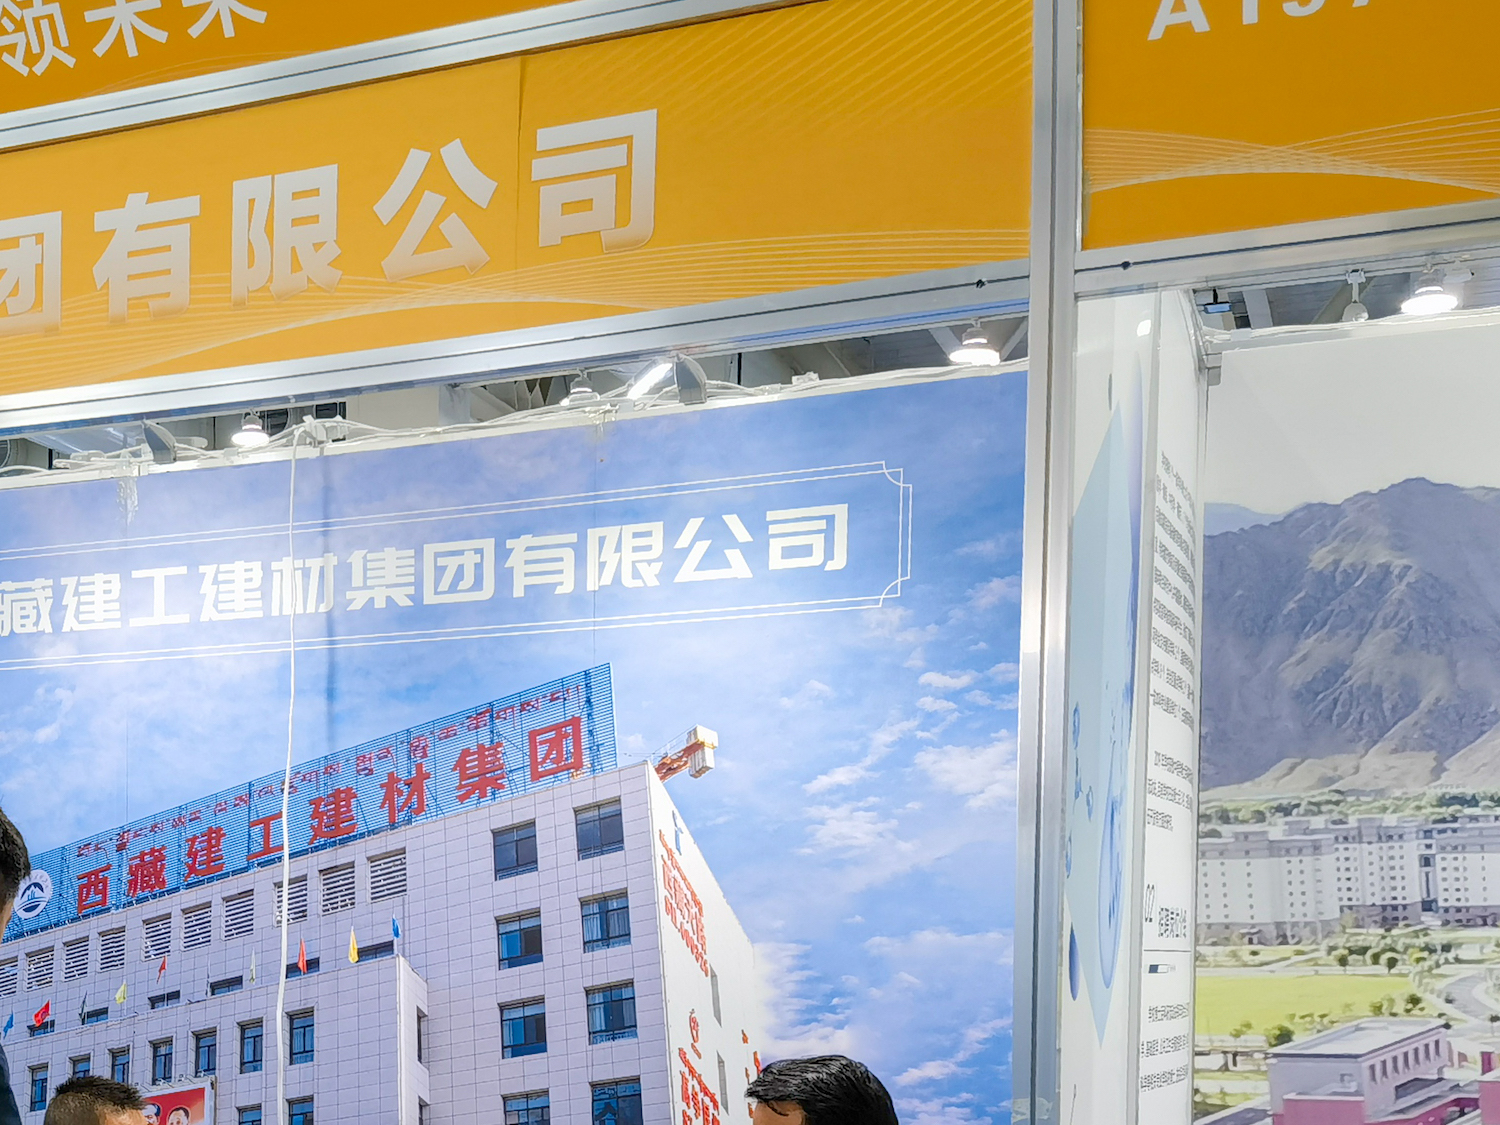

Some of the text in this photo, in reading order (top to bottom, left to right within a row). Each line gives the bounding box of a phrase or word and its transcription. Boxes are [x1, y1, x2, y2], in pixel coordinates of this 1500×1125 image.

[76, 715, 583, 914] 西藏建工建材集团
